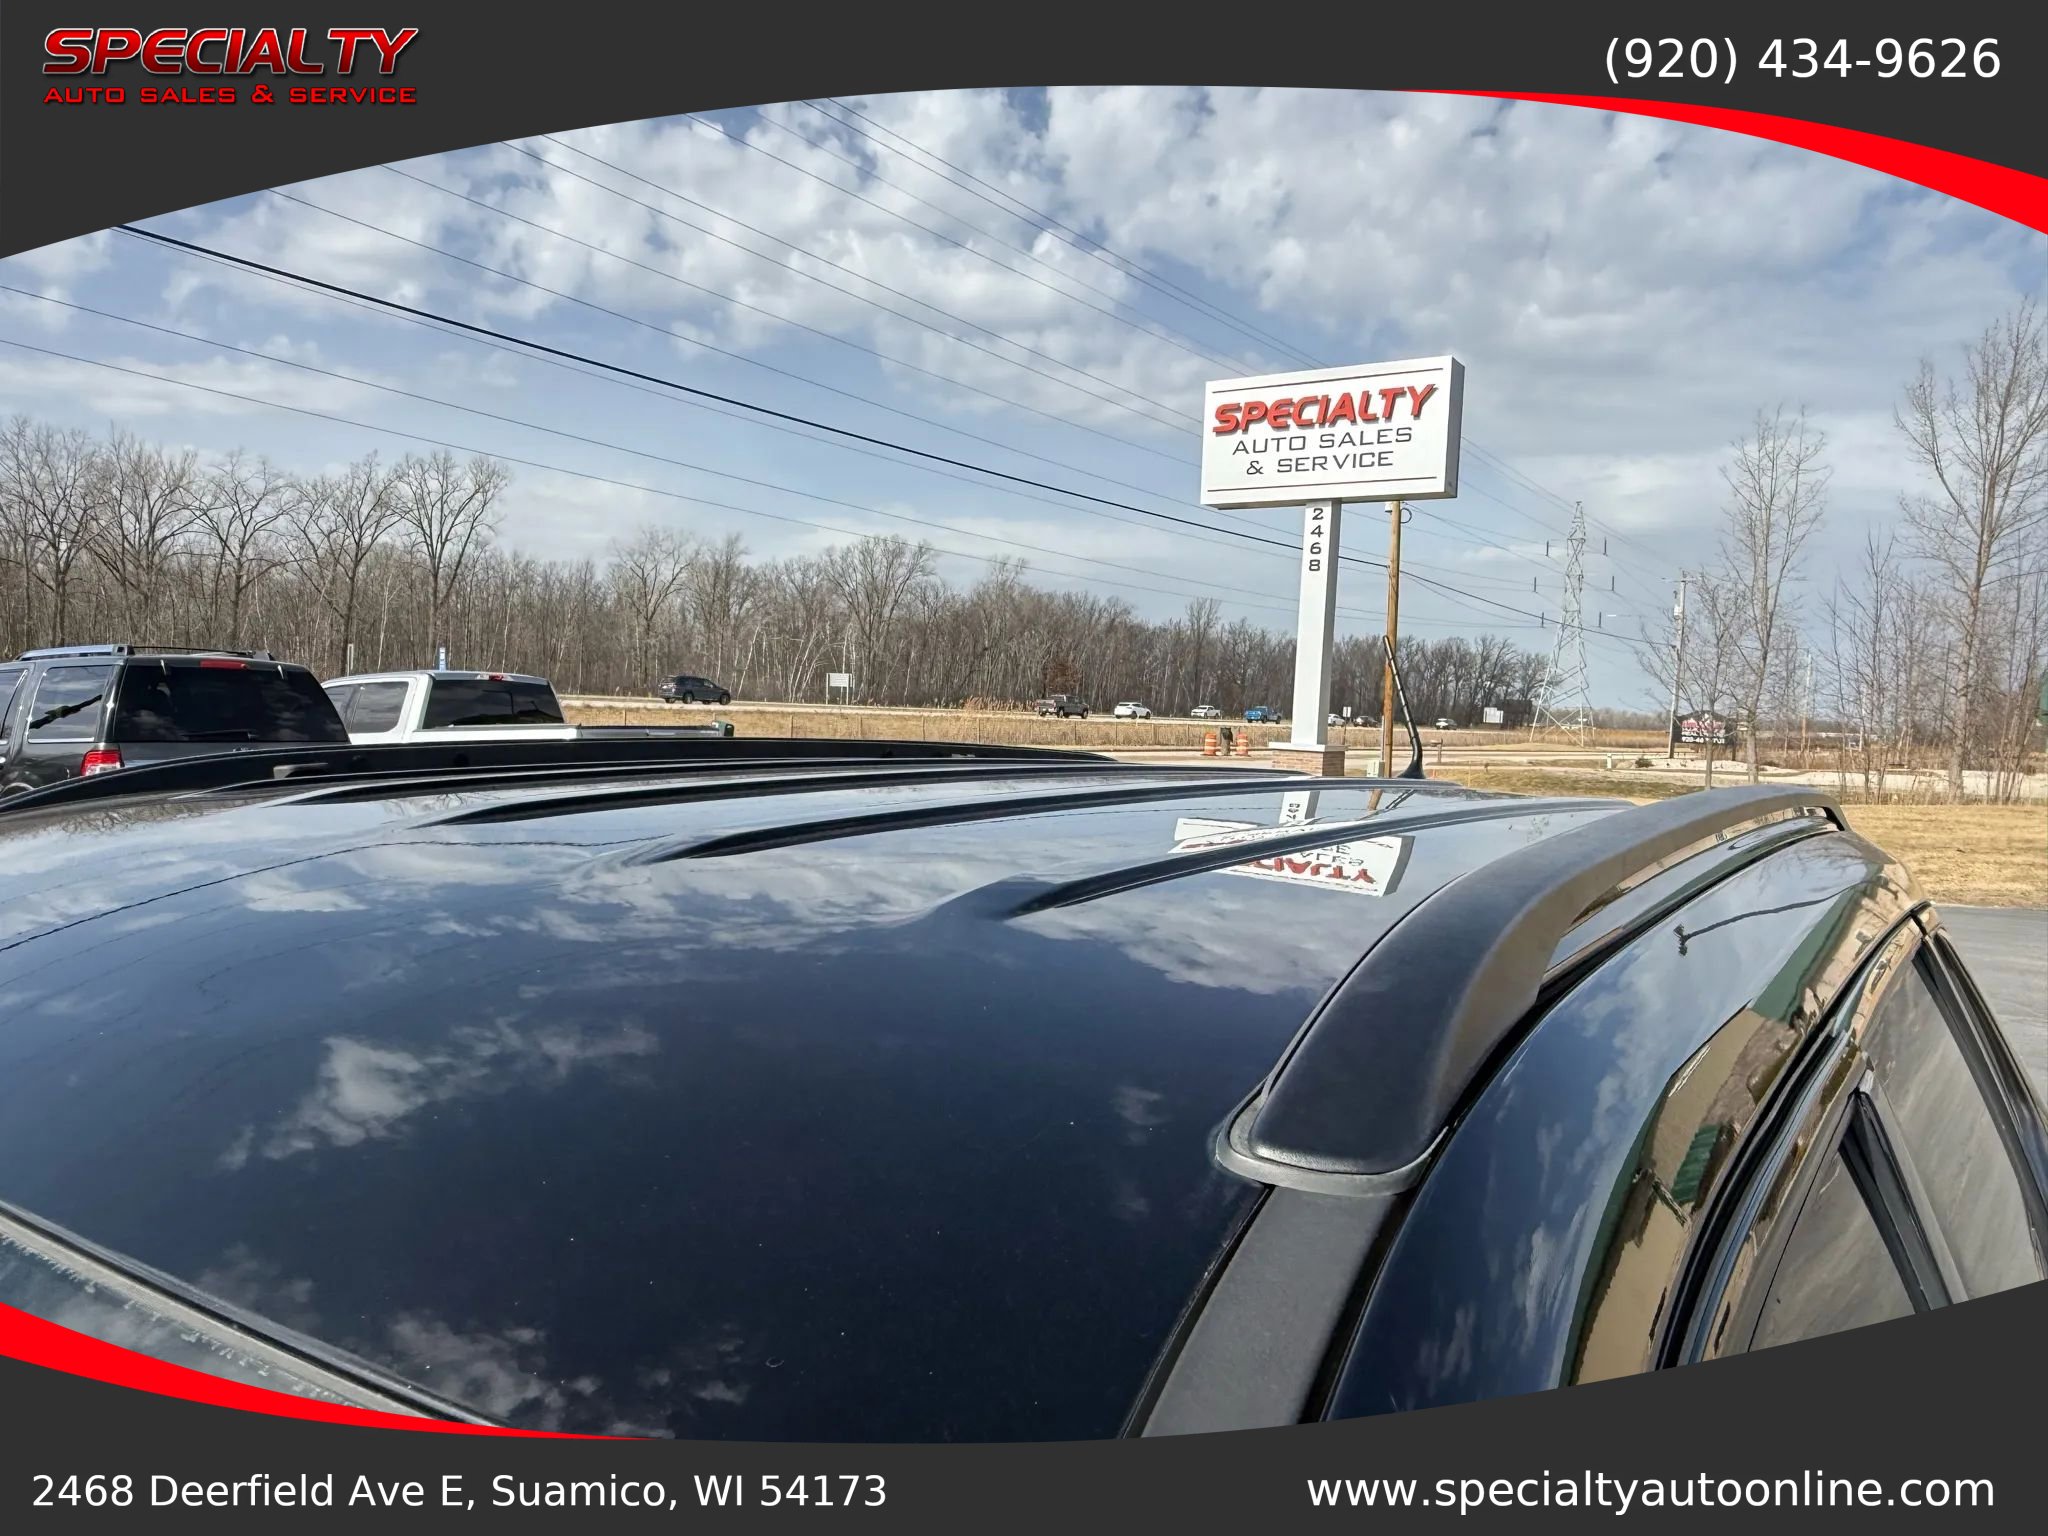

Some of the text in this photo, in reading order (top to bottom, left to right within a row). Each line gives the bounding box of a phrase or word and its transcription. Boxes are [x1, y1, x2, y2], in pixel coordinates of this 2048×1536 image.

[1212, 383, 1438, 436] SPECIALTY
[1232, 427, 1413, 456] AUTO SALES
[1246, 450, 1394, 476] & SERVICE
[1308, 507, 1324, 572] 2468
